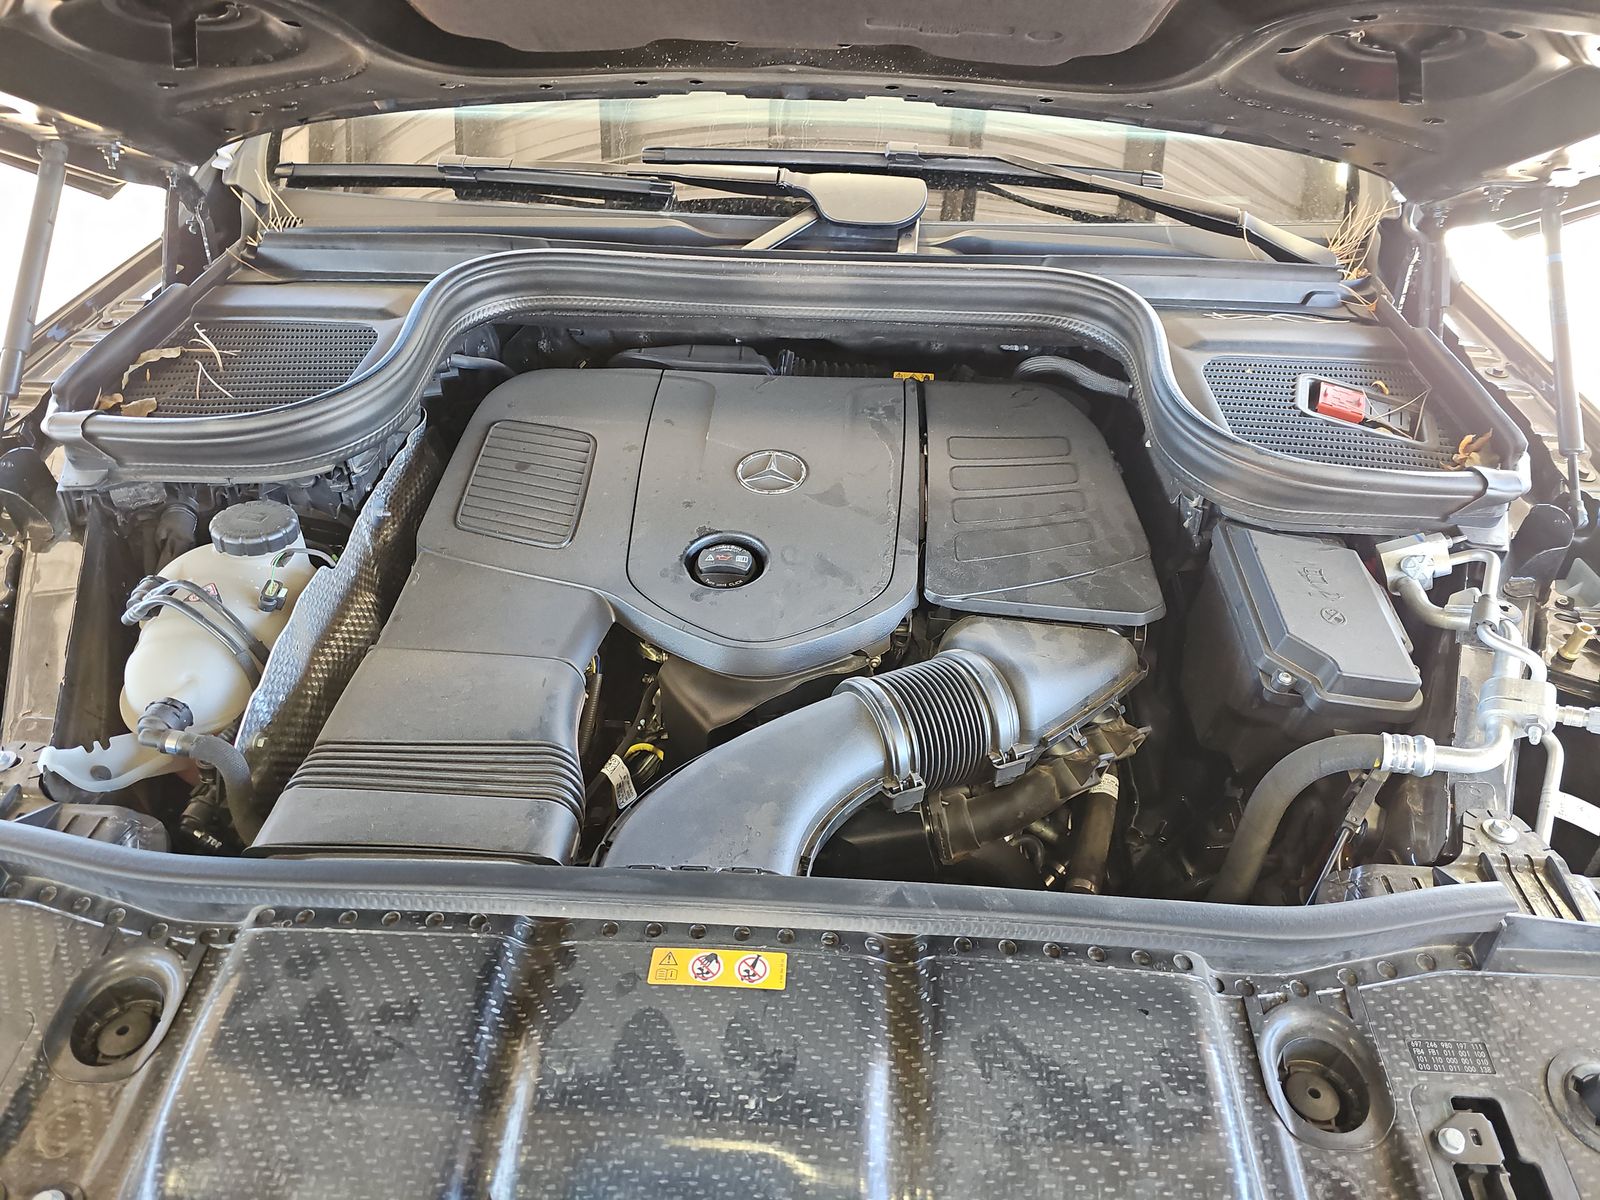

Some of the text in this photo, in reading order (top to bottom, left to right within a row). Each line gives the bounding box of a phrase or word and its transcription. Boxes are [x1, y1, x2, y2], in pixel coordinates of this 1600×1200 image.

[206, 835, 222, 848] TOP
[1410, 1040, 1422, 1048] 697
[1425, 1041, 1438, 1049] 246
[1427, 1048, 1440, 1056] FB1
[1416, 1055, 1428, 1063] 101
[1476, 1058, 1489, 1066] 010
[1464, 1065, 1477, 1073] 000
